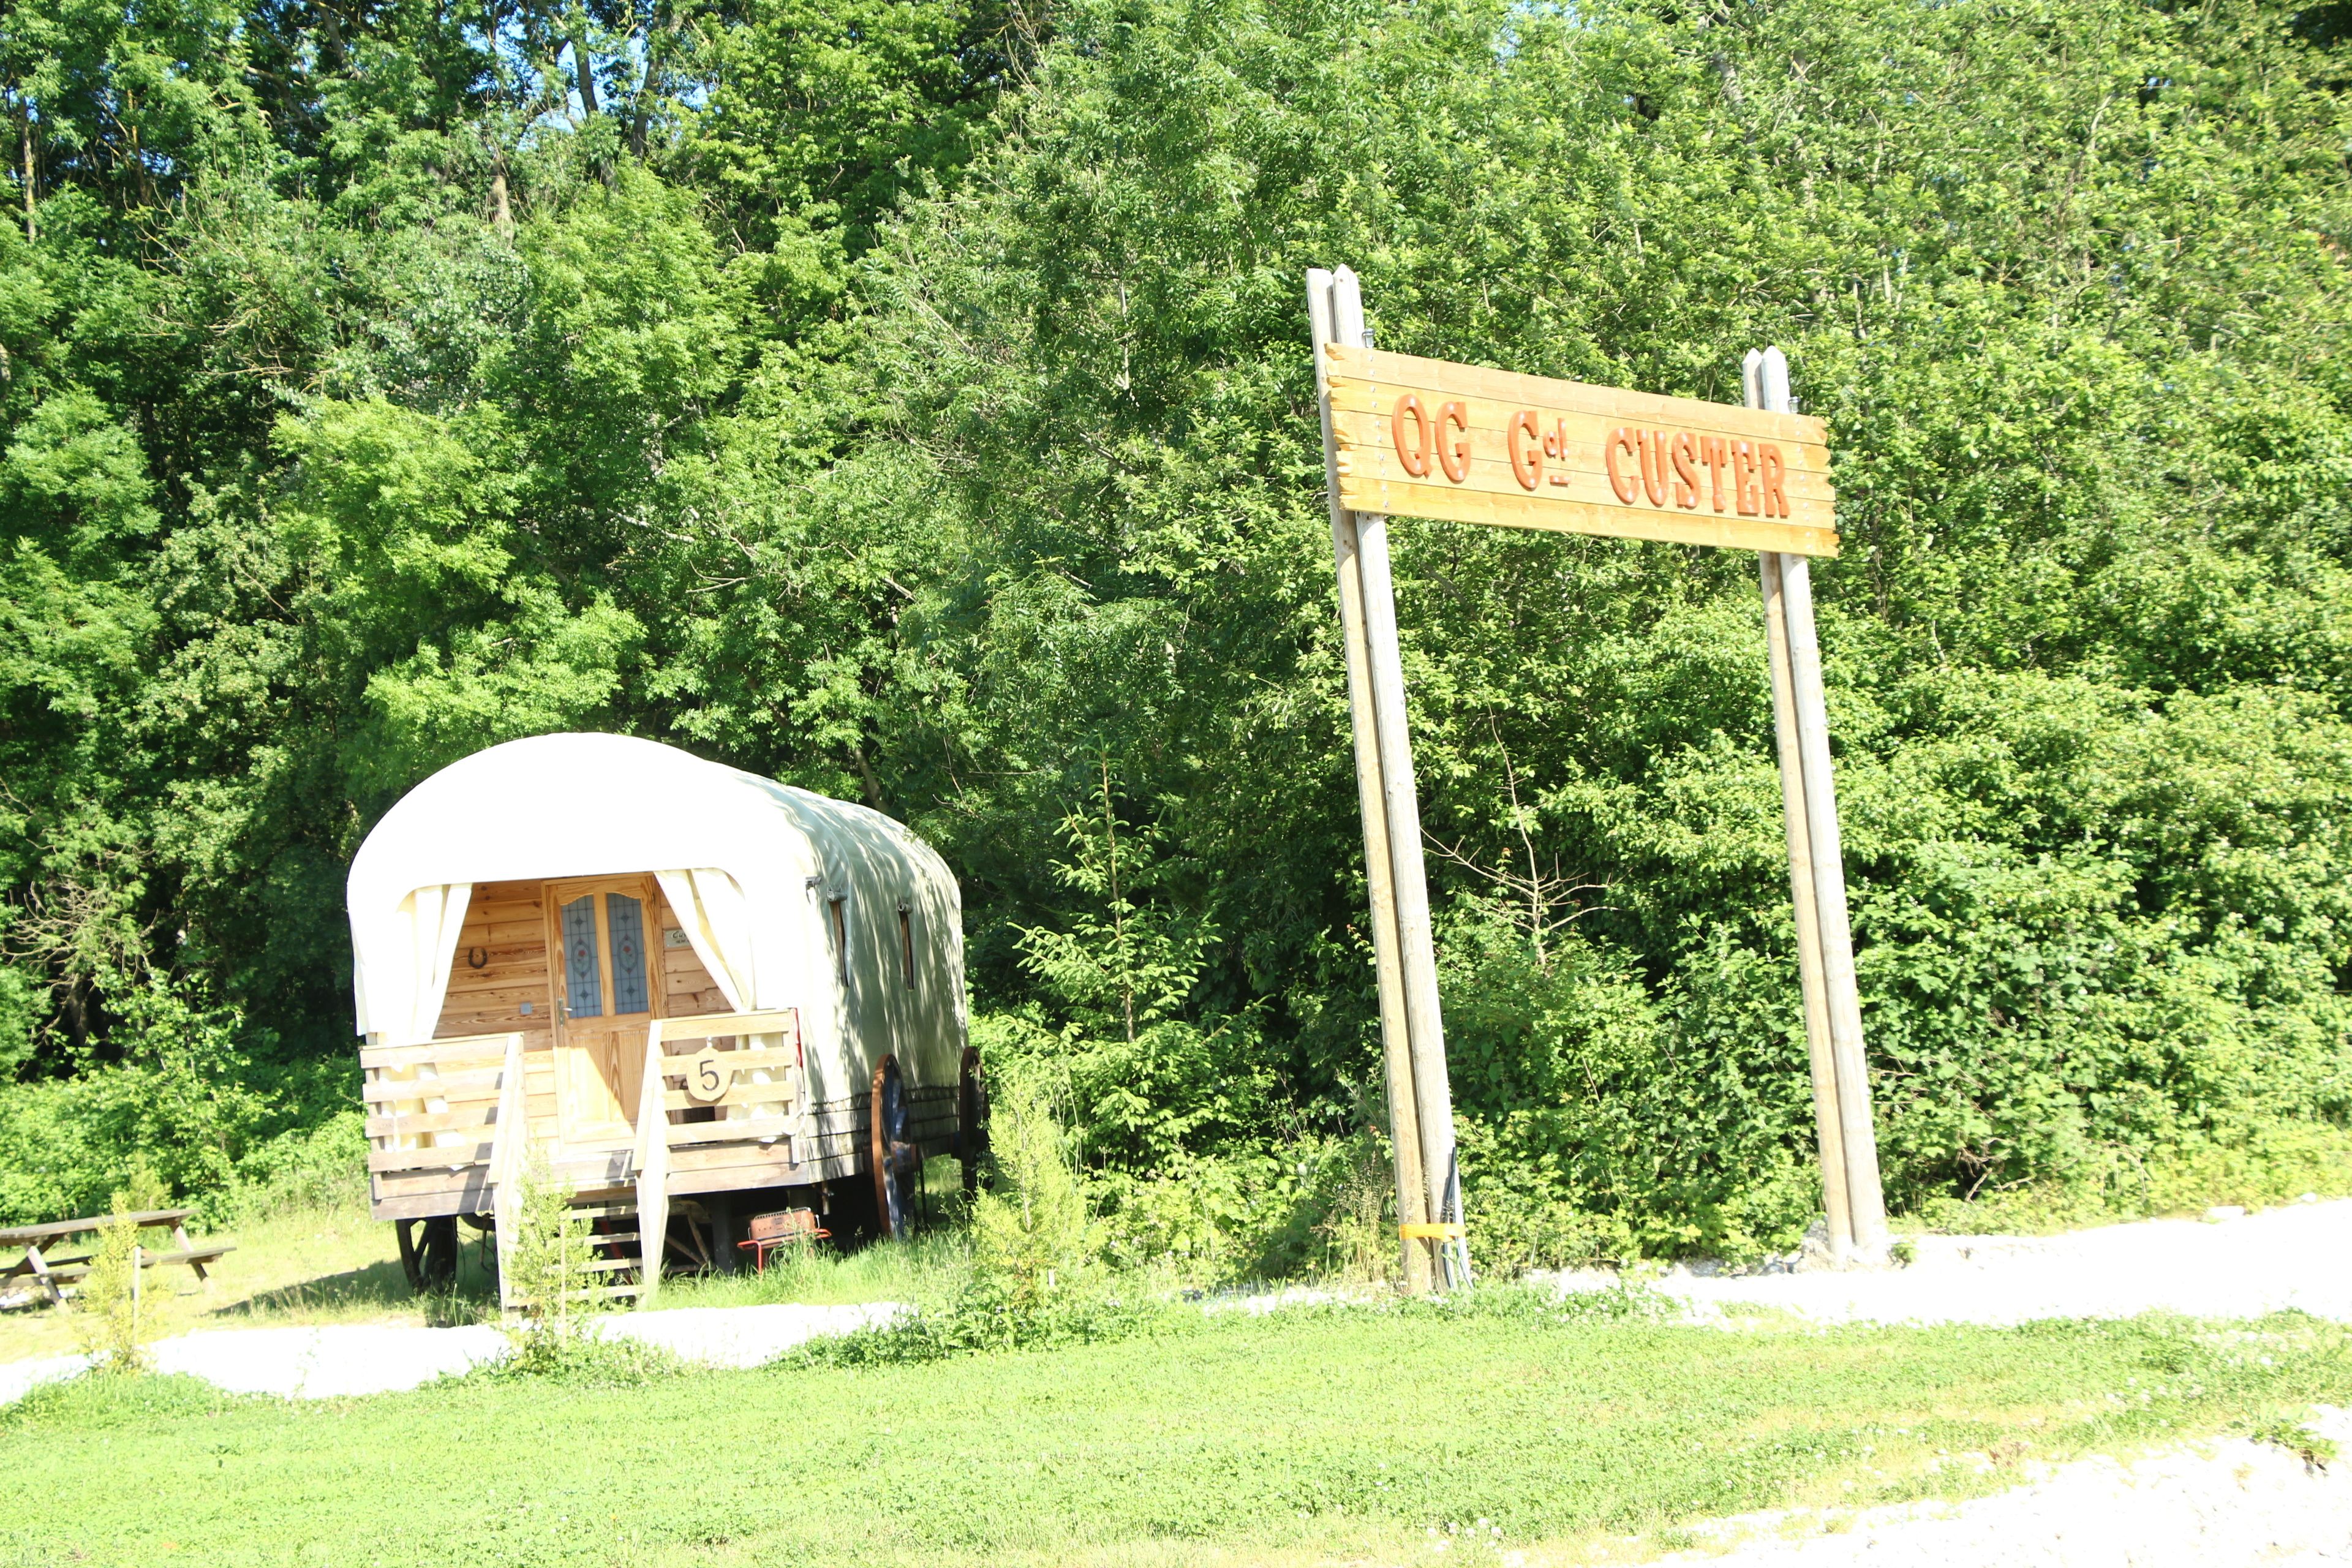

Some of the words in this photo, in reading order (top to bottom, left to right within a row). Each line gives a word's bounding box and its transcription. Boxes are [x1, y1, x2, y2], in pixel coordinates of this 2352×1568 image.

[1392, 394, 1471, 483] QG
[1605, 427, 1790, 518] CUSTER
[699, 1060, 719, 1091] 5
